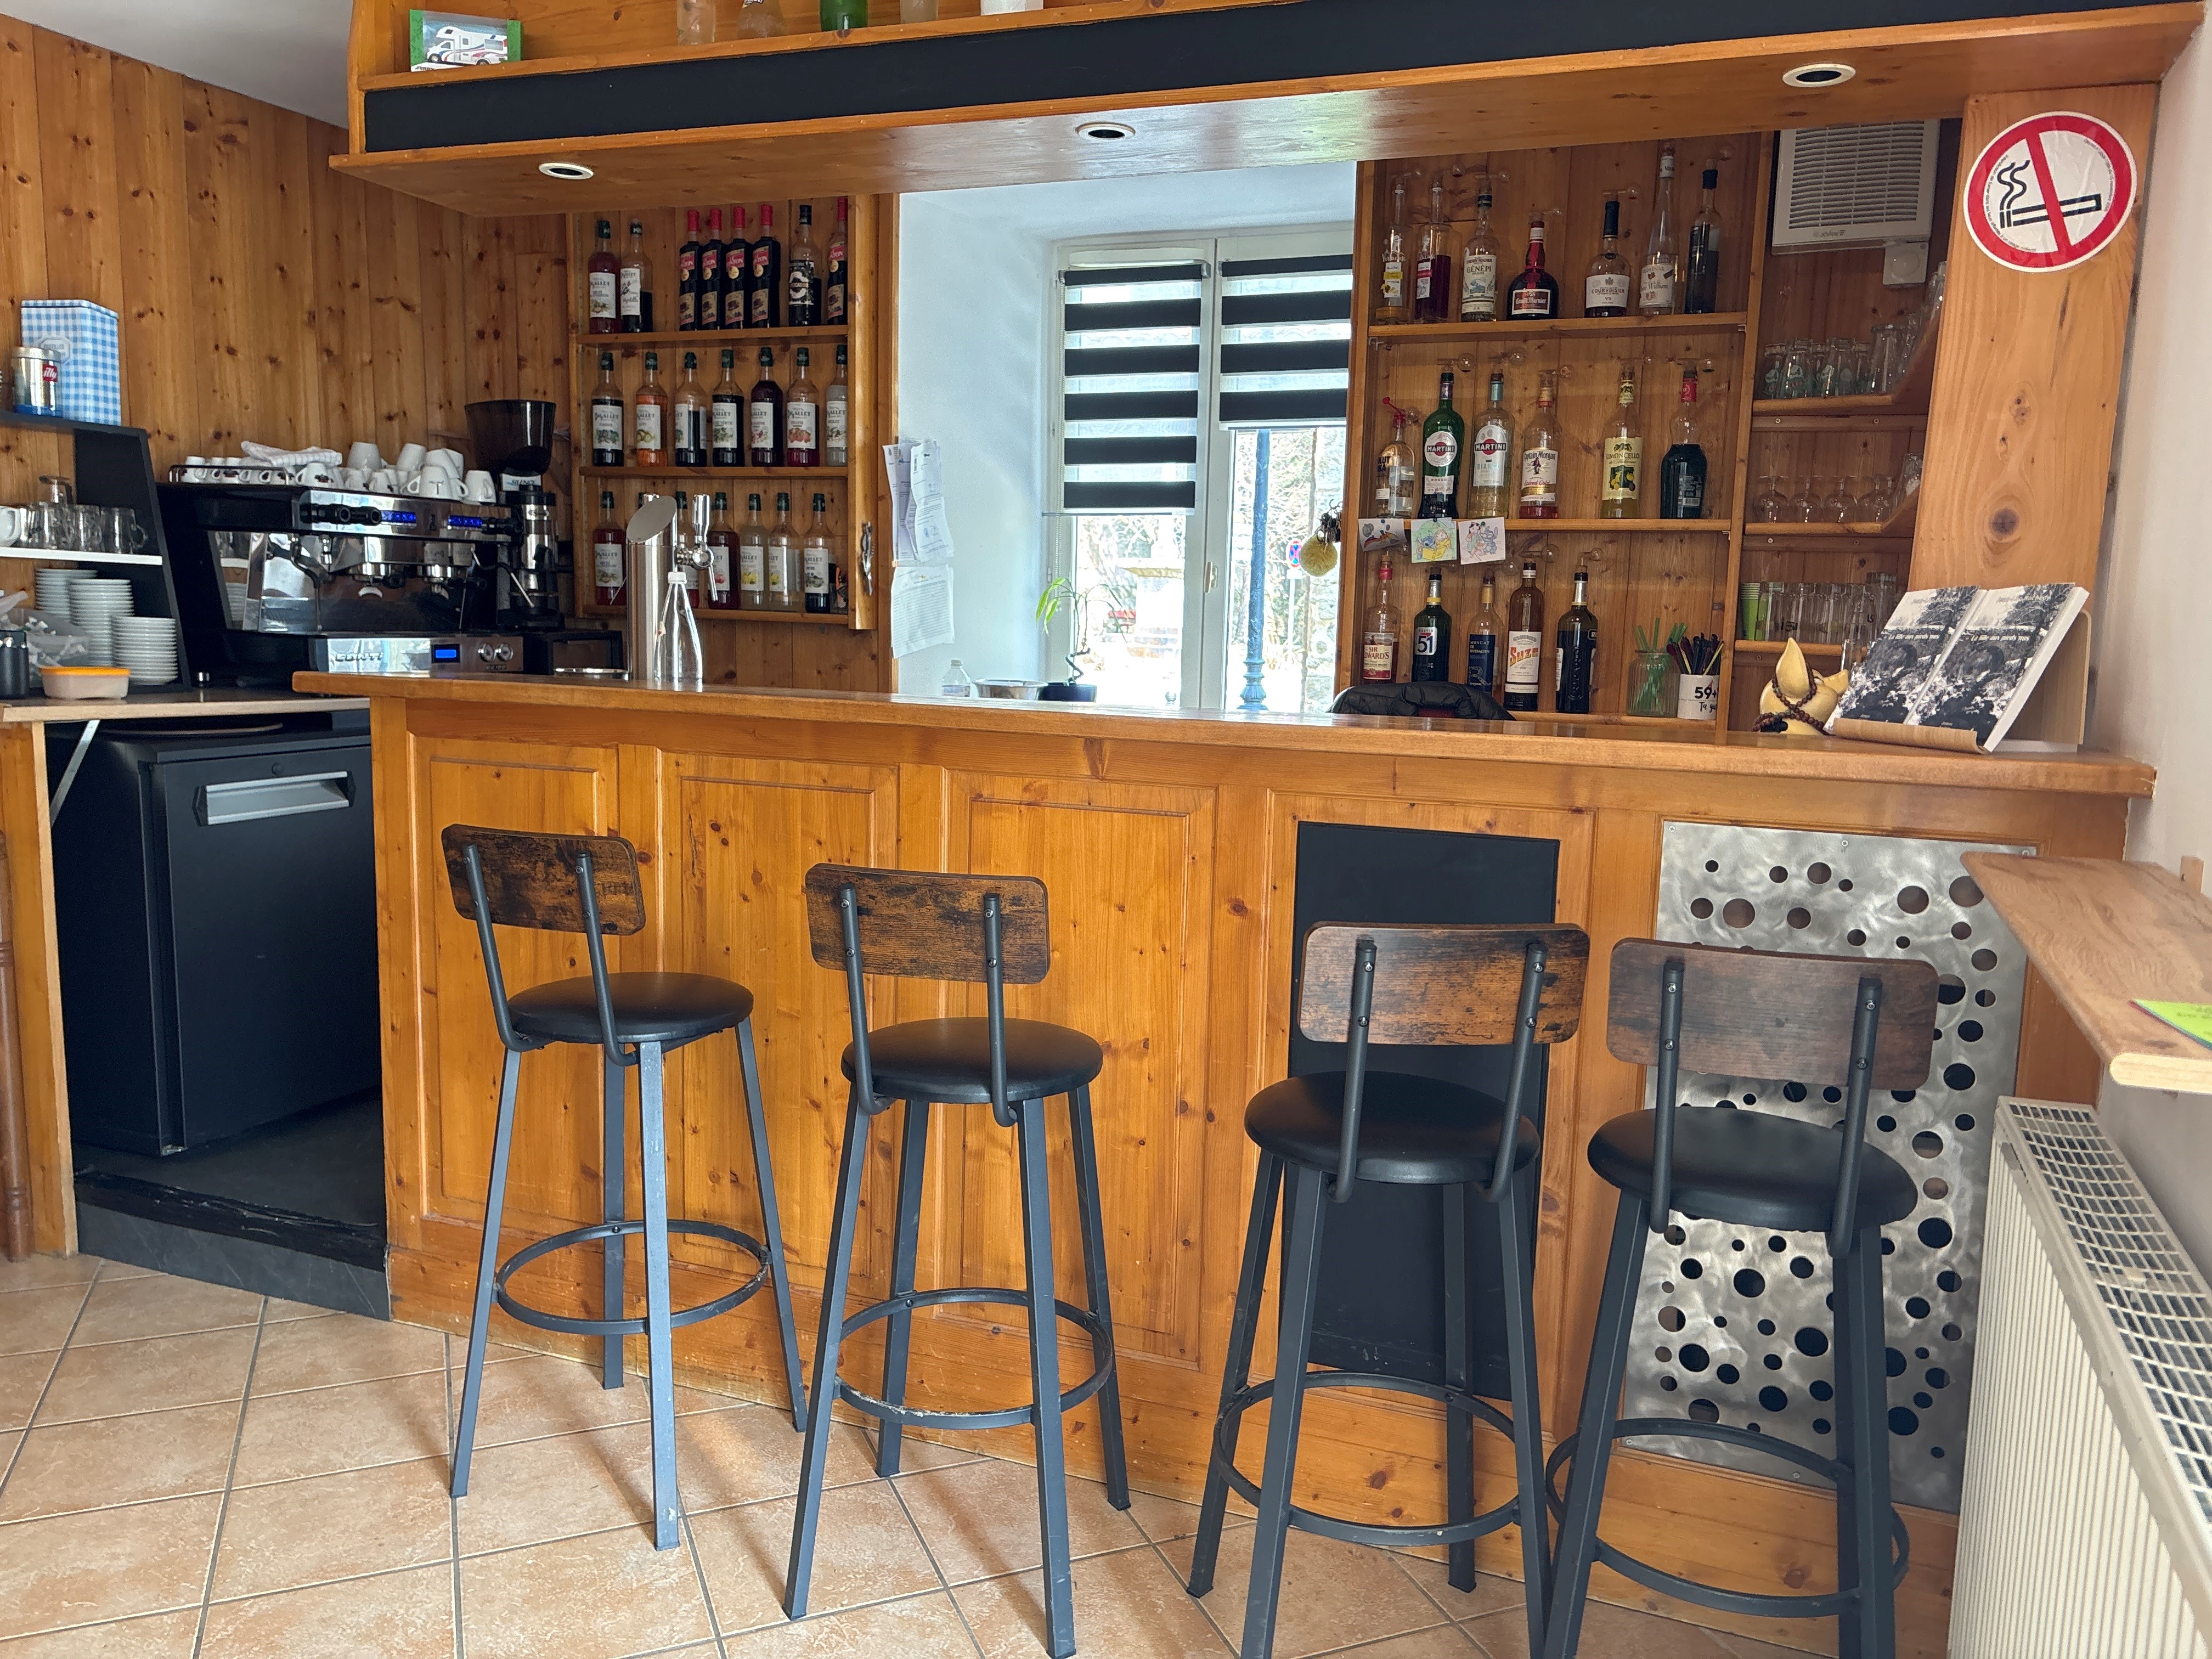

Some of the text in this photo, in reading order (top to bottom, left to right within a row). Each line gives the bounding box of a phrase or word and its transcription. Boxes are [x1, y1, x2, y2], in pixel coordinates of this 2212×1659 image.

[1467, 264, 1492, 273] GÉNÉPI
[44, 367, 57, 380] illy
[1417, 635, 1434, 653] 51
